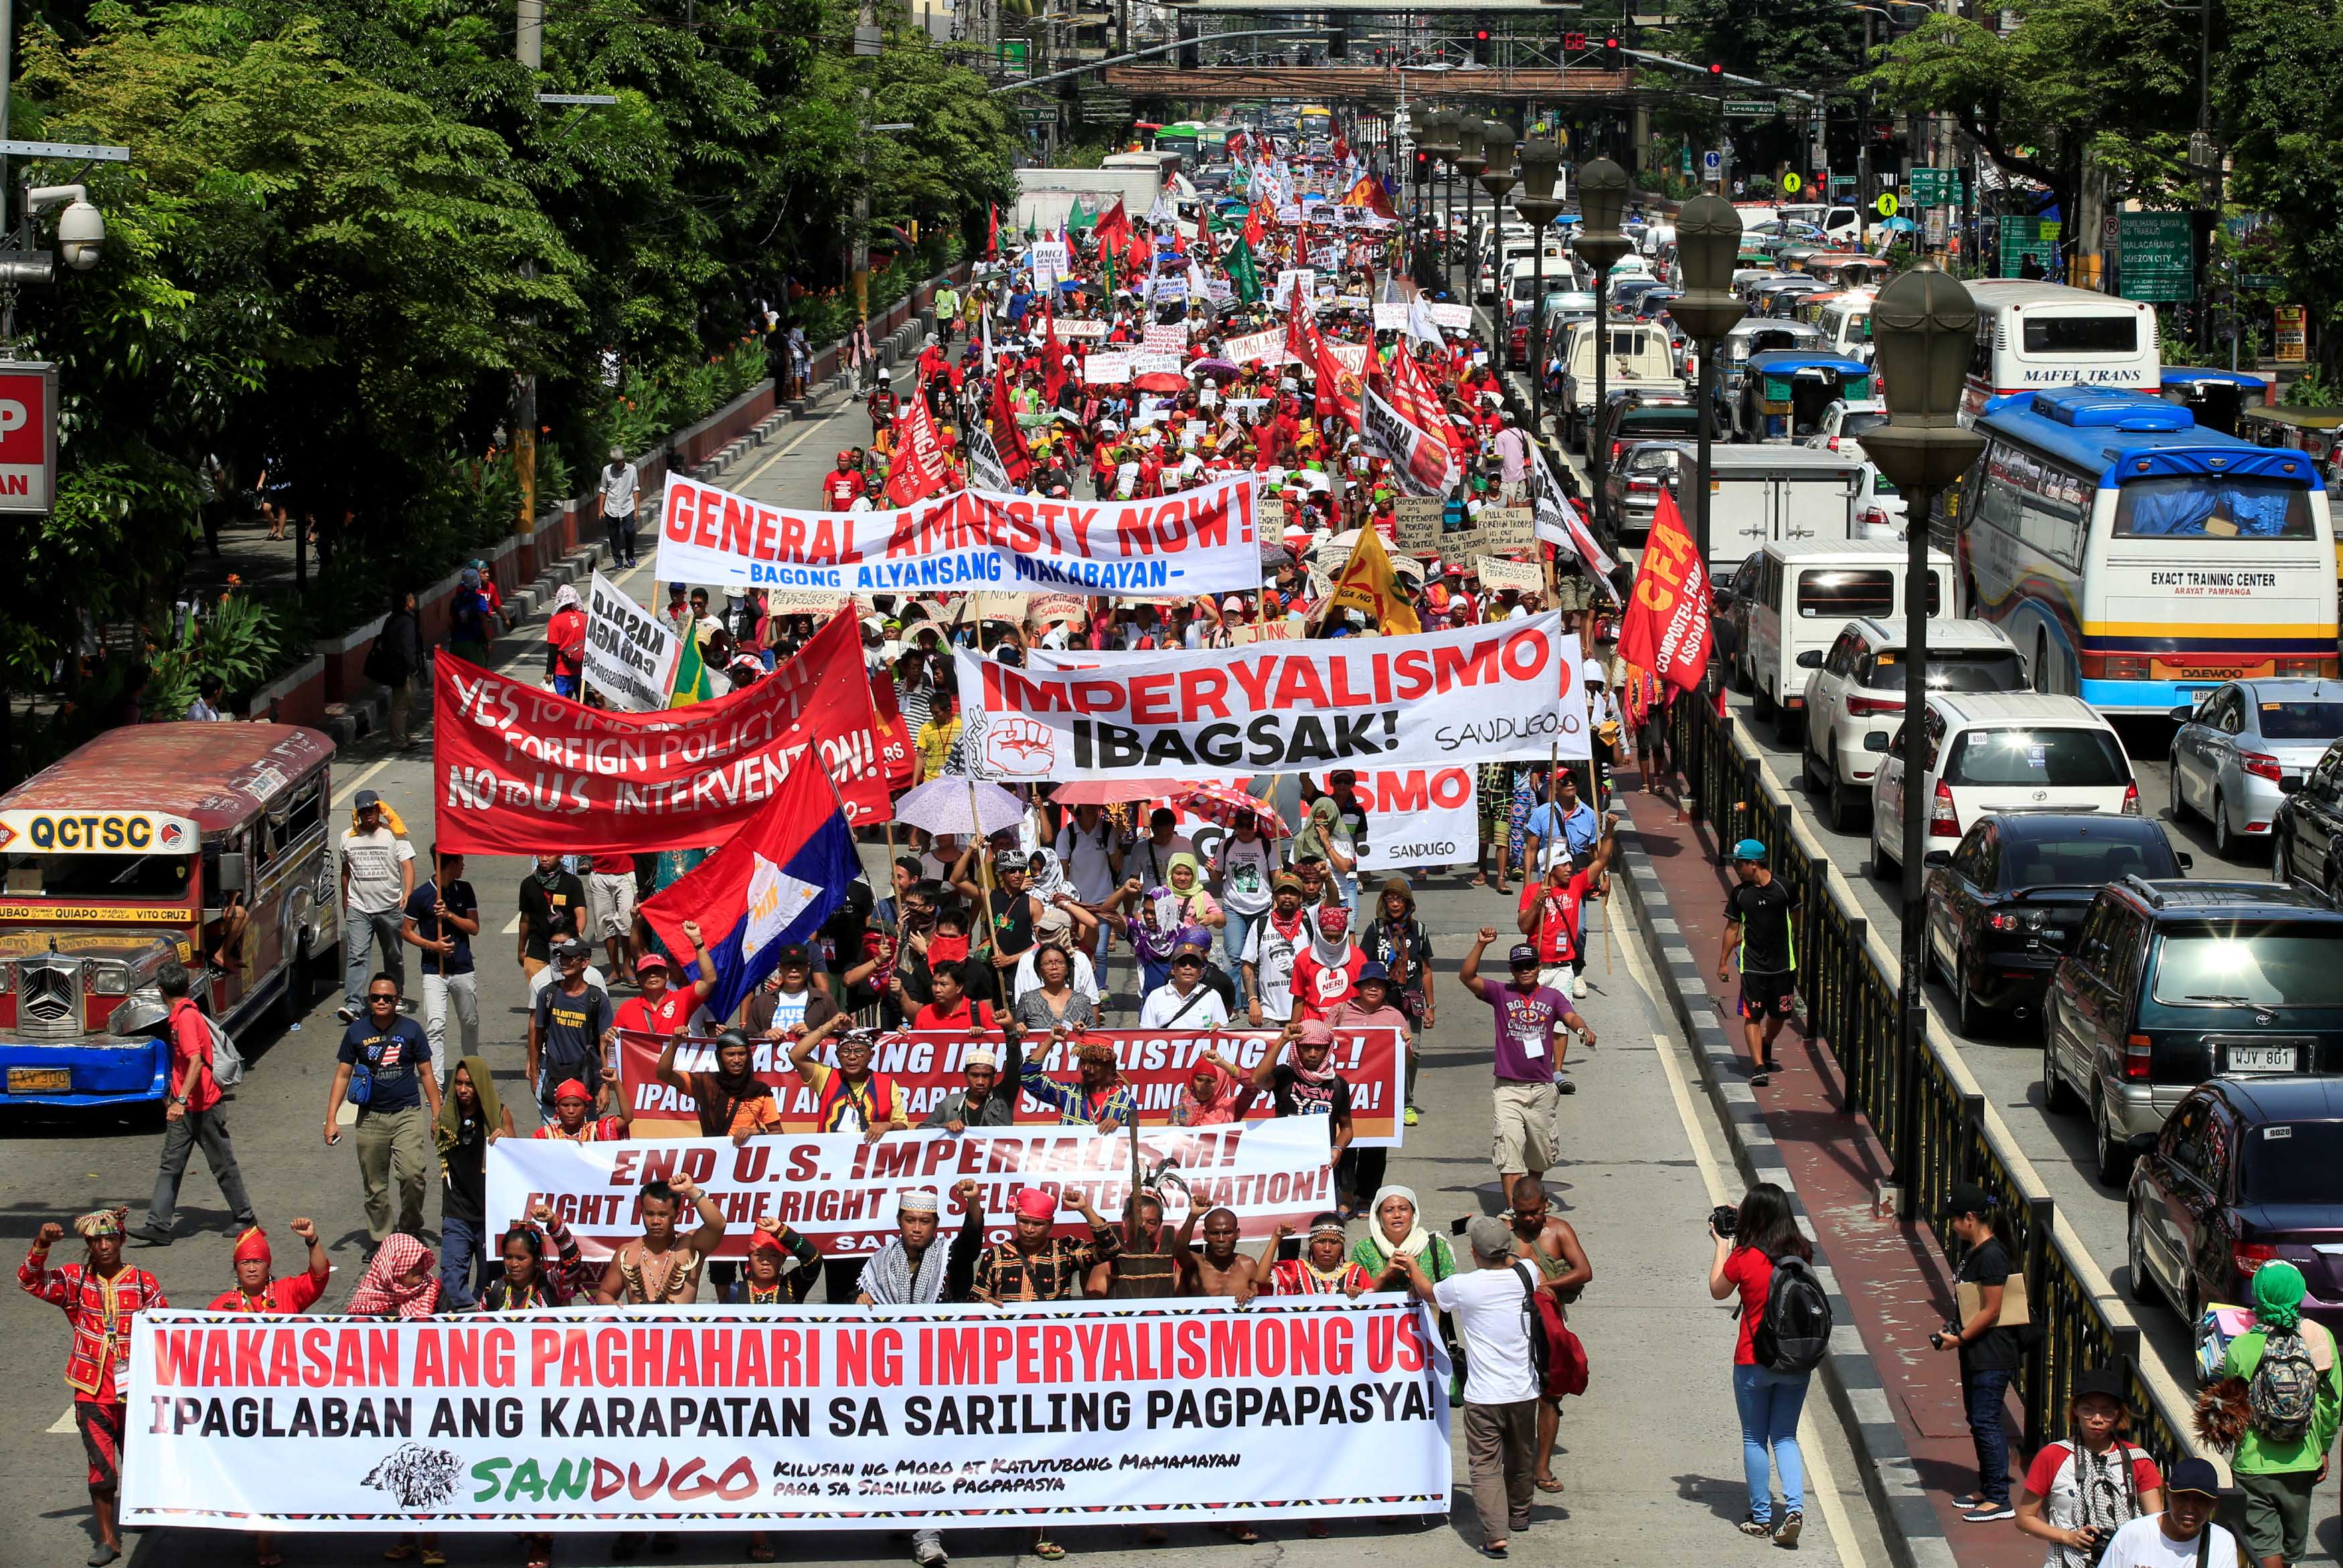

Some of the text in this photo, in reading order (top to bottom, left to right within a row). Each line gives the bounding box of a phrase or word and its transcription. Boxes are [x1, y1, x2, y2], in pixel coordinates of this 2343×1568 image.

[2123, 254, 2172, 263] QUEZON CITY
[2023, 369, 2142, 382] MAFEL TRANS
[666, 482, 1254, 565] GENERAL AMNESTY NOW!
[1478, 521, 1508, 529] FOREIGN
[1485, 511, 1520, 519] PULL-OUT
[858, 553, 1001, 588] ALYANSANG
[1637, 522, 1693, 612] CFA
[2151, 572, 2276, 587] EXACT TRAINING CENTER
[2174, 587, 2252, 596] ARAYAT PAMPANGA
[981, 628, 1550, 725] IMPERYALISMO
[2181, 669, 2244, 679] DAEWOO
[451, 674, 521, 730] YES
[530, 696, 567, 722] TO
[504, 691, 801, 776] FOREIGN POLICY!
[1072, 710, 1399, 770] IBAGSAK!
[1434, 711, 1559, 752] SANDUGO
[447, 765, 499, 811] NO
[534, 771, 592, 815] U.S.
[615, 729, 878, 815] INTERVENTON!
[30, 816, 151, 850] QCTSC
[1389, 841, 1456, 860] SANDUGO
[0, 907, 29, 918] UBAO
[55, 909, 98, 920] QUIAPO
[136, 910, 187, 920] VITO CRUZ
[1321, 978, 1344, 990] NERI
[2235, 1050, 2289, 1066] WJV 801
[374, 1071, 402, 1080] HAMPS
[1291, 1082, 1335, 1101] NEW
[2269, 1128, 2291, 1138] 9028
[609, 1128, 1244, 1187] END U.S. IMPERIALISM!
[779, 1188, 888, 1225] RIGHT
[154, 1311, 1435, 1388] WAKASAN ANG PAGHAHARI NG IMPERYALISMONG US!
[149, 1380, 1436, 1439] IPAGLABAN ANG KARAPATAN SA SARILING PAGPAPASYA!
[773, 1452, 1241, 1480] KILUSAN NG MORO AT KATUTUBONG MAMAMAYAN
[473, 1455, 760, 1503] SANDUGO
[773, 1474, 1066, 1497] PARA SA SARILING PAGPAPASYA
